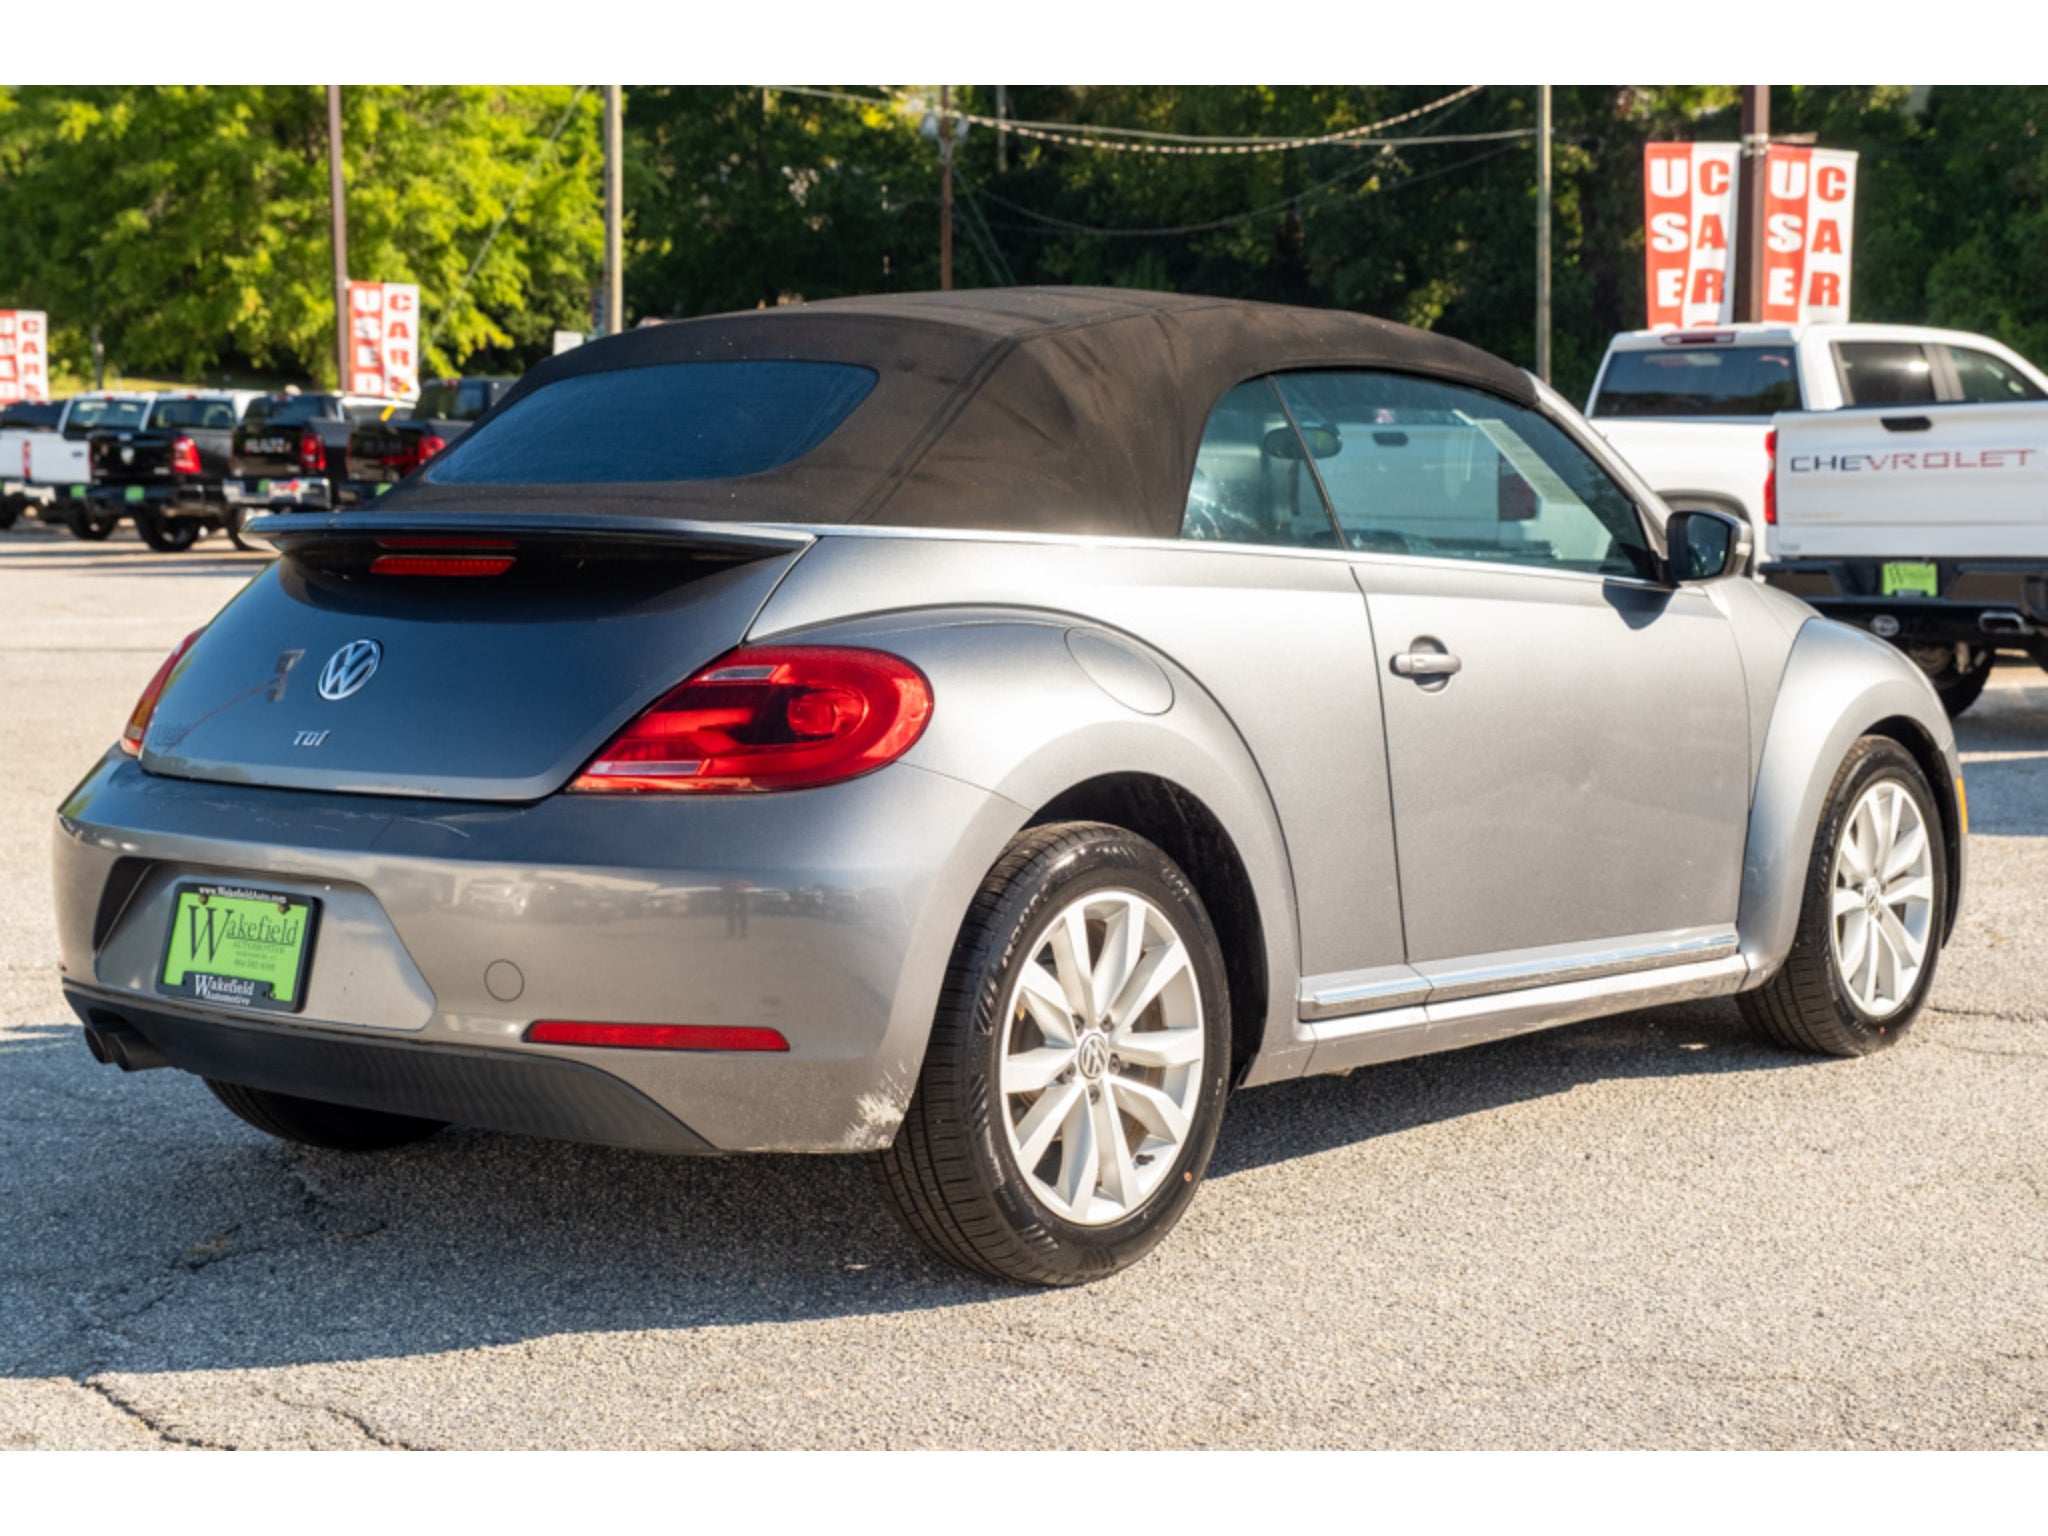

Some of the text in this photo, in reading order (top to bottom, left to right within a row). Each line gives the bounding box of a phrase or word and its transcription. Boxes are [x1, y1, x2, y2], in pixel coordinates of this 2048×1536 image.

[1650, 158, 1689, 330] USE
[1691, 159, 1730, 327] CAR
[1767, 159, 1807, 306] USE
[1808, 166, 1847, 306] CAR
[353, 289, 382, 395] USED
[389, 294, 412, 394] CARS
[1790, 449, 2037, 473] CHEVROLET
[188, 904, 299, 964] Wakefield
[195, 974, 254, 996] Wakefield
